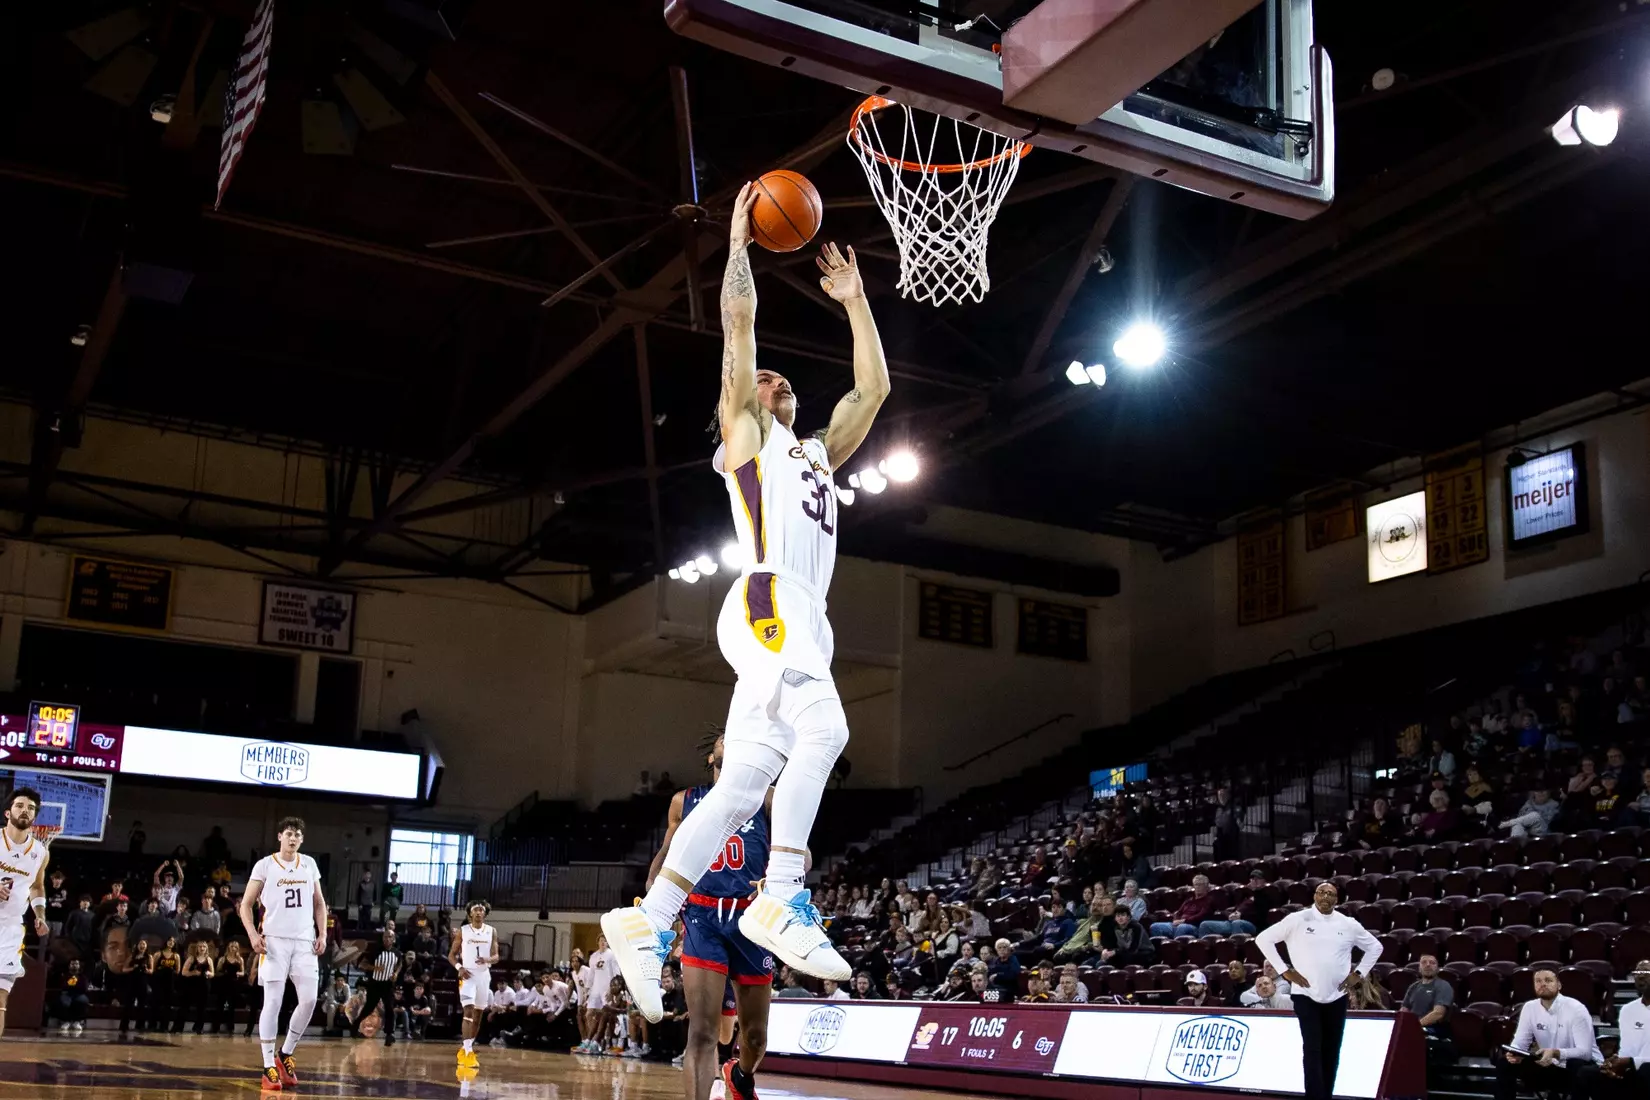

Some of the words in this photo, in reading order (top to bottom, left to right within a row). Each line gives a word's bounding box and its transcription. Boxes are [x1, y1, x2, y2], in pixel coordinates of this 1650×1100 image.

[801, 470, 834, 537] 30
[1514, 480, 1573, 510] meijer
[278, 628, 318, 644] SWEET
[321, 633, 334, 647] 16
[39, 706, 74, 723] 10:05
[35, 721, 67, 747] 28
[62, 755, 68, 763] 3
[73, 756, 106, 767] FOULS:
[110, 760, 116, 768] 2
[246, 746, 305, 767] MEMBERS
[257, 764, 291, 781] FIRST
[285, 888, 302, 908] 21
[983, 990, 1000, 1001] POSS
[806, 1010, 844, 1031] MEMBERS
[968, 1016, 1007, 1039] 10:05
[806, 1032, 830, 1050] FIRST
[941, 1026, 959, 1047] 17
[1012, 1030, 1024, 1050] 6
[1176, 1023, 1244, 1052] MEMBERS
[960, 1047, 966, 1058] 1
[967, 1048, 987, 1059] FOULS
[987, 1048, 996, 1060] 2
[1182, 1053, 1224, 1078] FIRST
